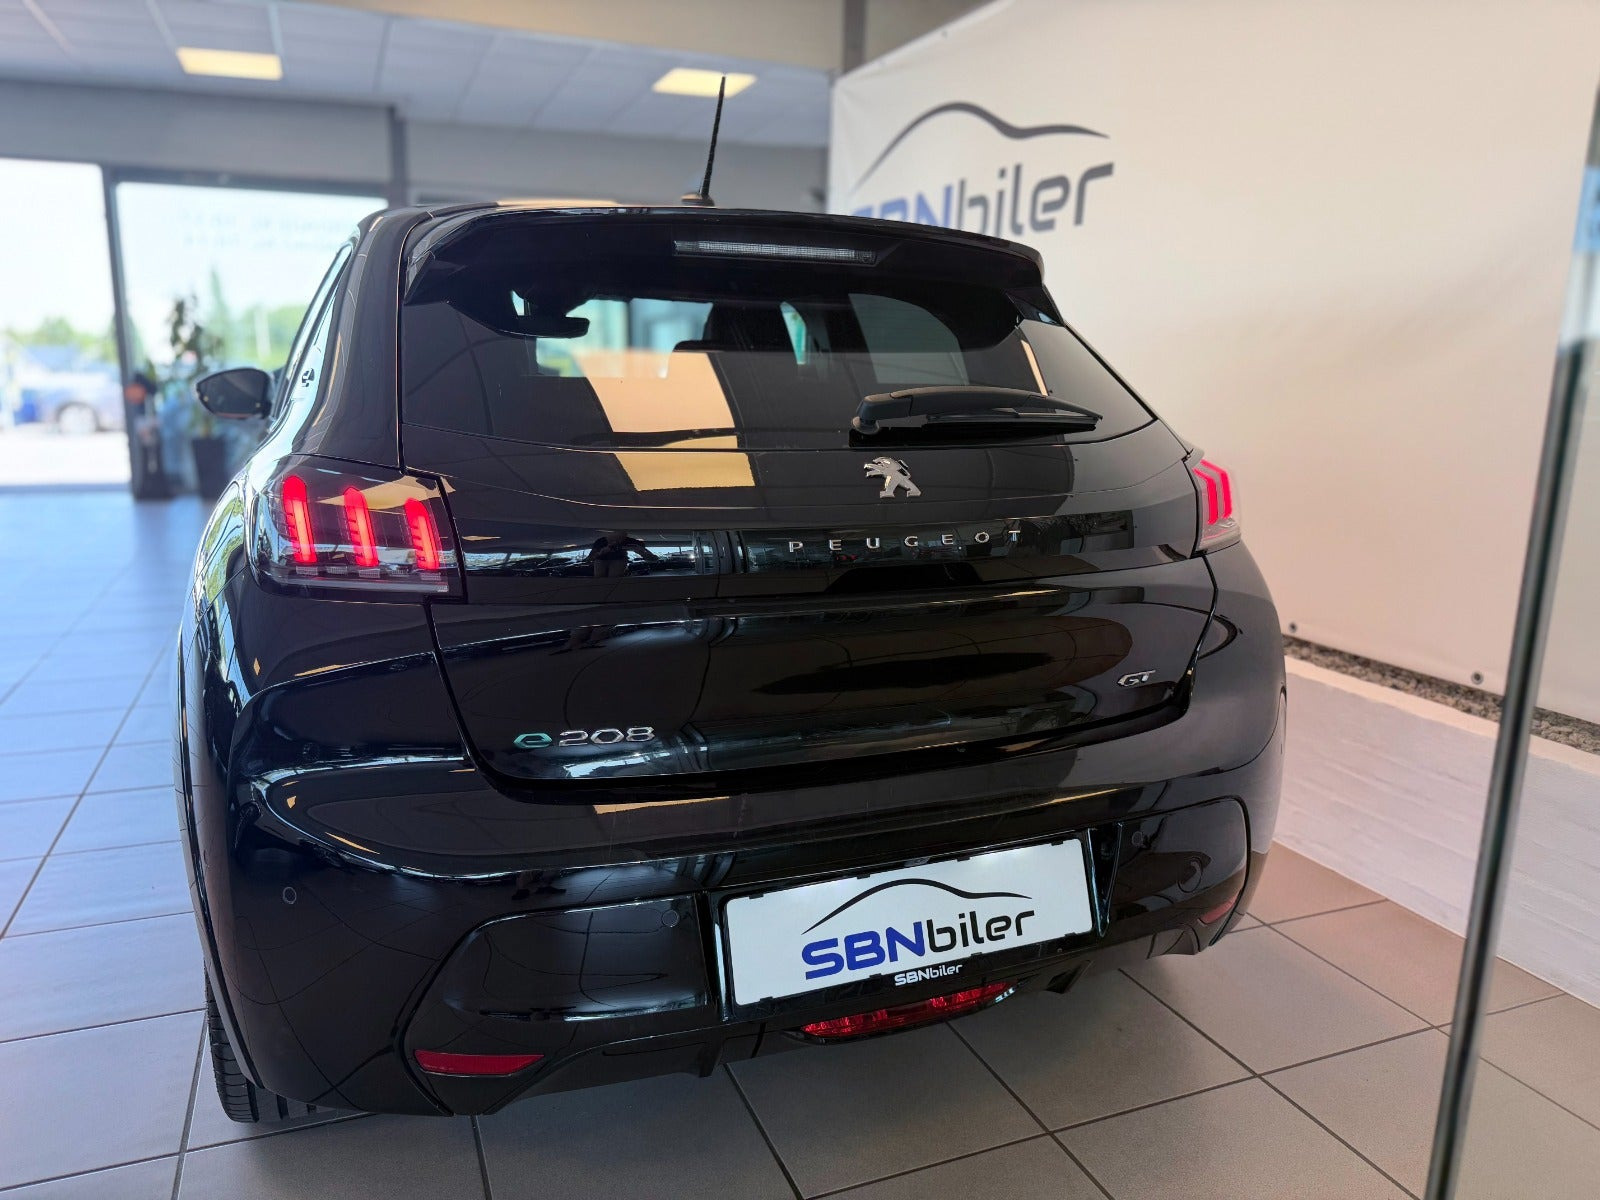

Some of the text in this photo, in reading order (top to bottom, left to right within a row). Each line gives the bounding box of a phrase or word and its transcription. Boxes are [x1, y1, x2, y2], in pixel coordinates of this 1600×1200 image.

[849, 161, 1114, 237] Nbiler
[788, 529, 1021, 553] PEUGEOT
[1117, 669, 1156, 687] GT
[801, 910, 1035, 980] SBNbiler
[894, 964, 963, 987] SBNbiler
